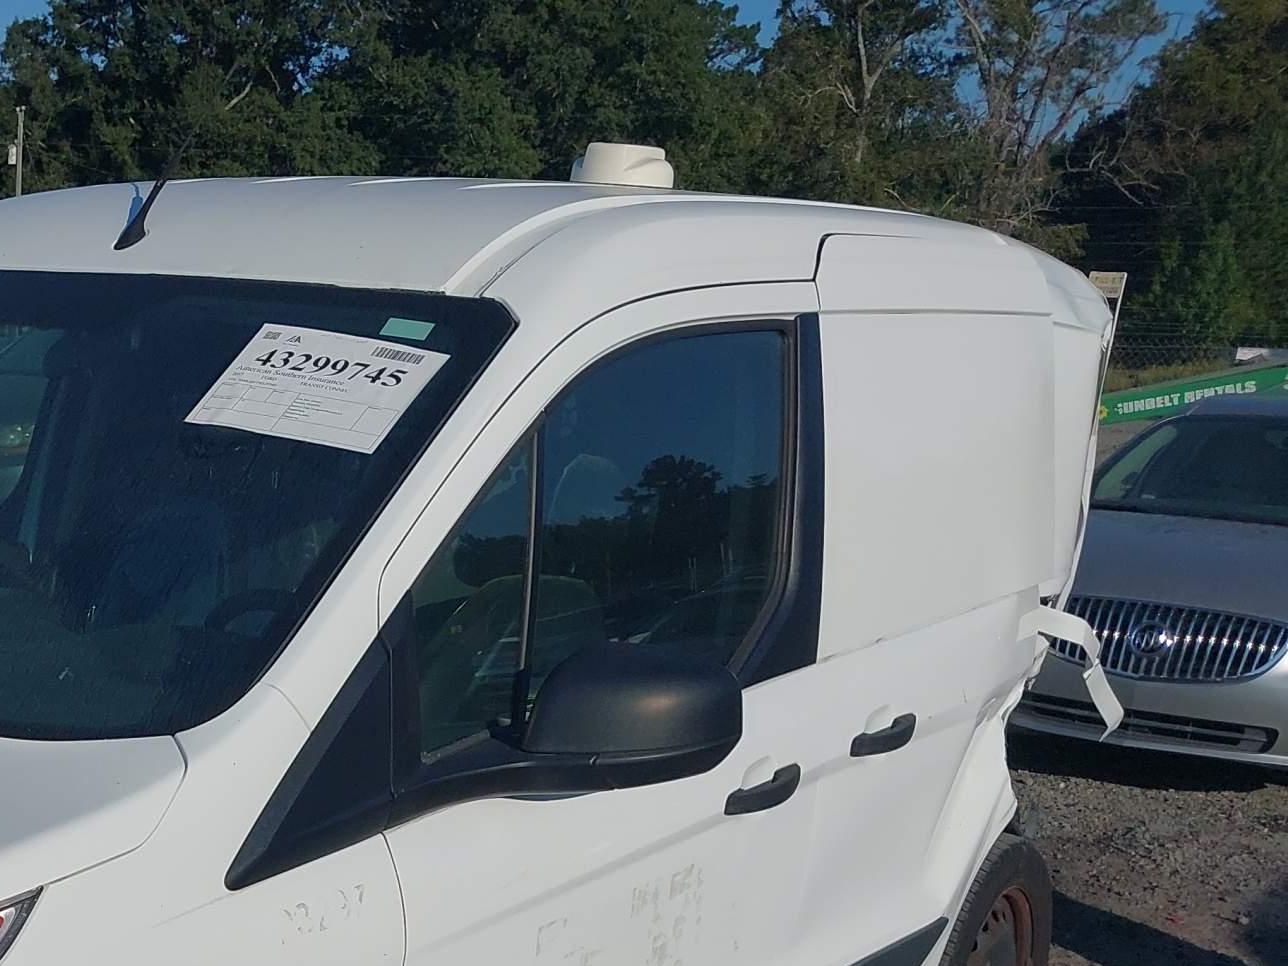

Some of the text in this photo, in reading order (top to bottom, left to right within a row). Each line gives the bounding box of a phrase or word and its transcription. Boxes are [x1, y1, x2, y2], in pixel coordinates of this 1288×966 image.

[235, 364, 346, 387] American Southern Insurance
[254, 348, 409, 388] 43299745
